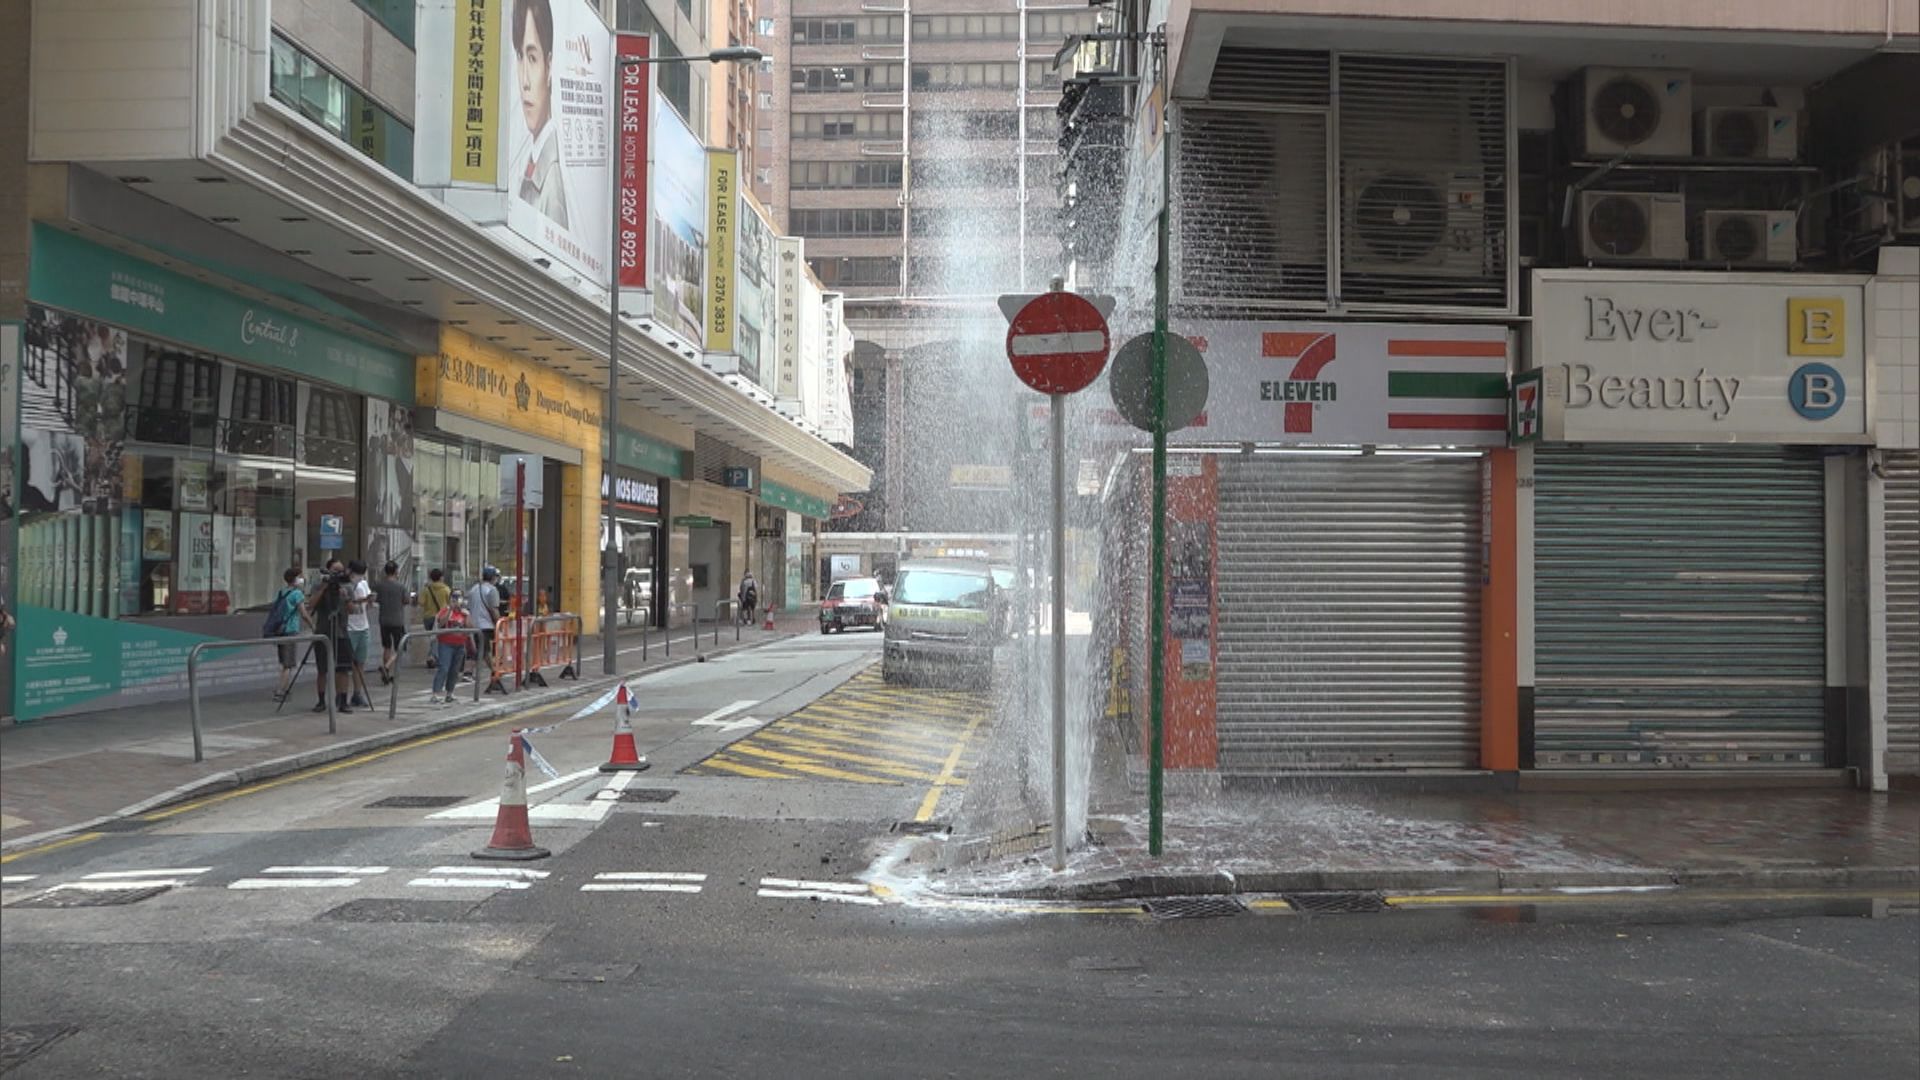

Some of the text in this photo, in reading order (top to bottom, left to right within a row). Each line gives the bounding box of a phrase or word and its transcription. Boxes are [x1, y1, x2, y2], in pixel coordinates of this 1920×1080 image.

[624, 54, 640, 85] FOR
[623, 89, 639, 132] LEASE
[717, 169, 728, 193] FOR
[621, 188, 637, 225] 2267
[716, 197, 727, 233] LEASE
[621, 230, 637, 268] 8922
[241, 309, 287, 344] Central
[1584, 295, 1719, 344] Ever-
[1801, 308, 1834, 345] E
[1262, 332, 1336, 433] 7
[1561, 362, 1741, 421] Beauty
[1802, 373, 1837, 410] B
[631, 480, 659, 507] BURGER
